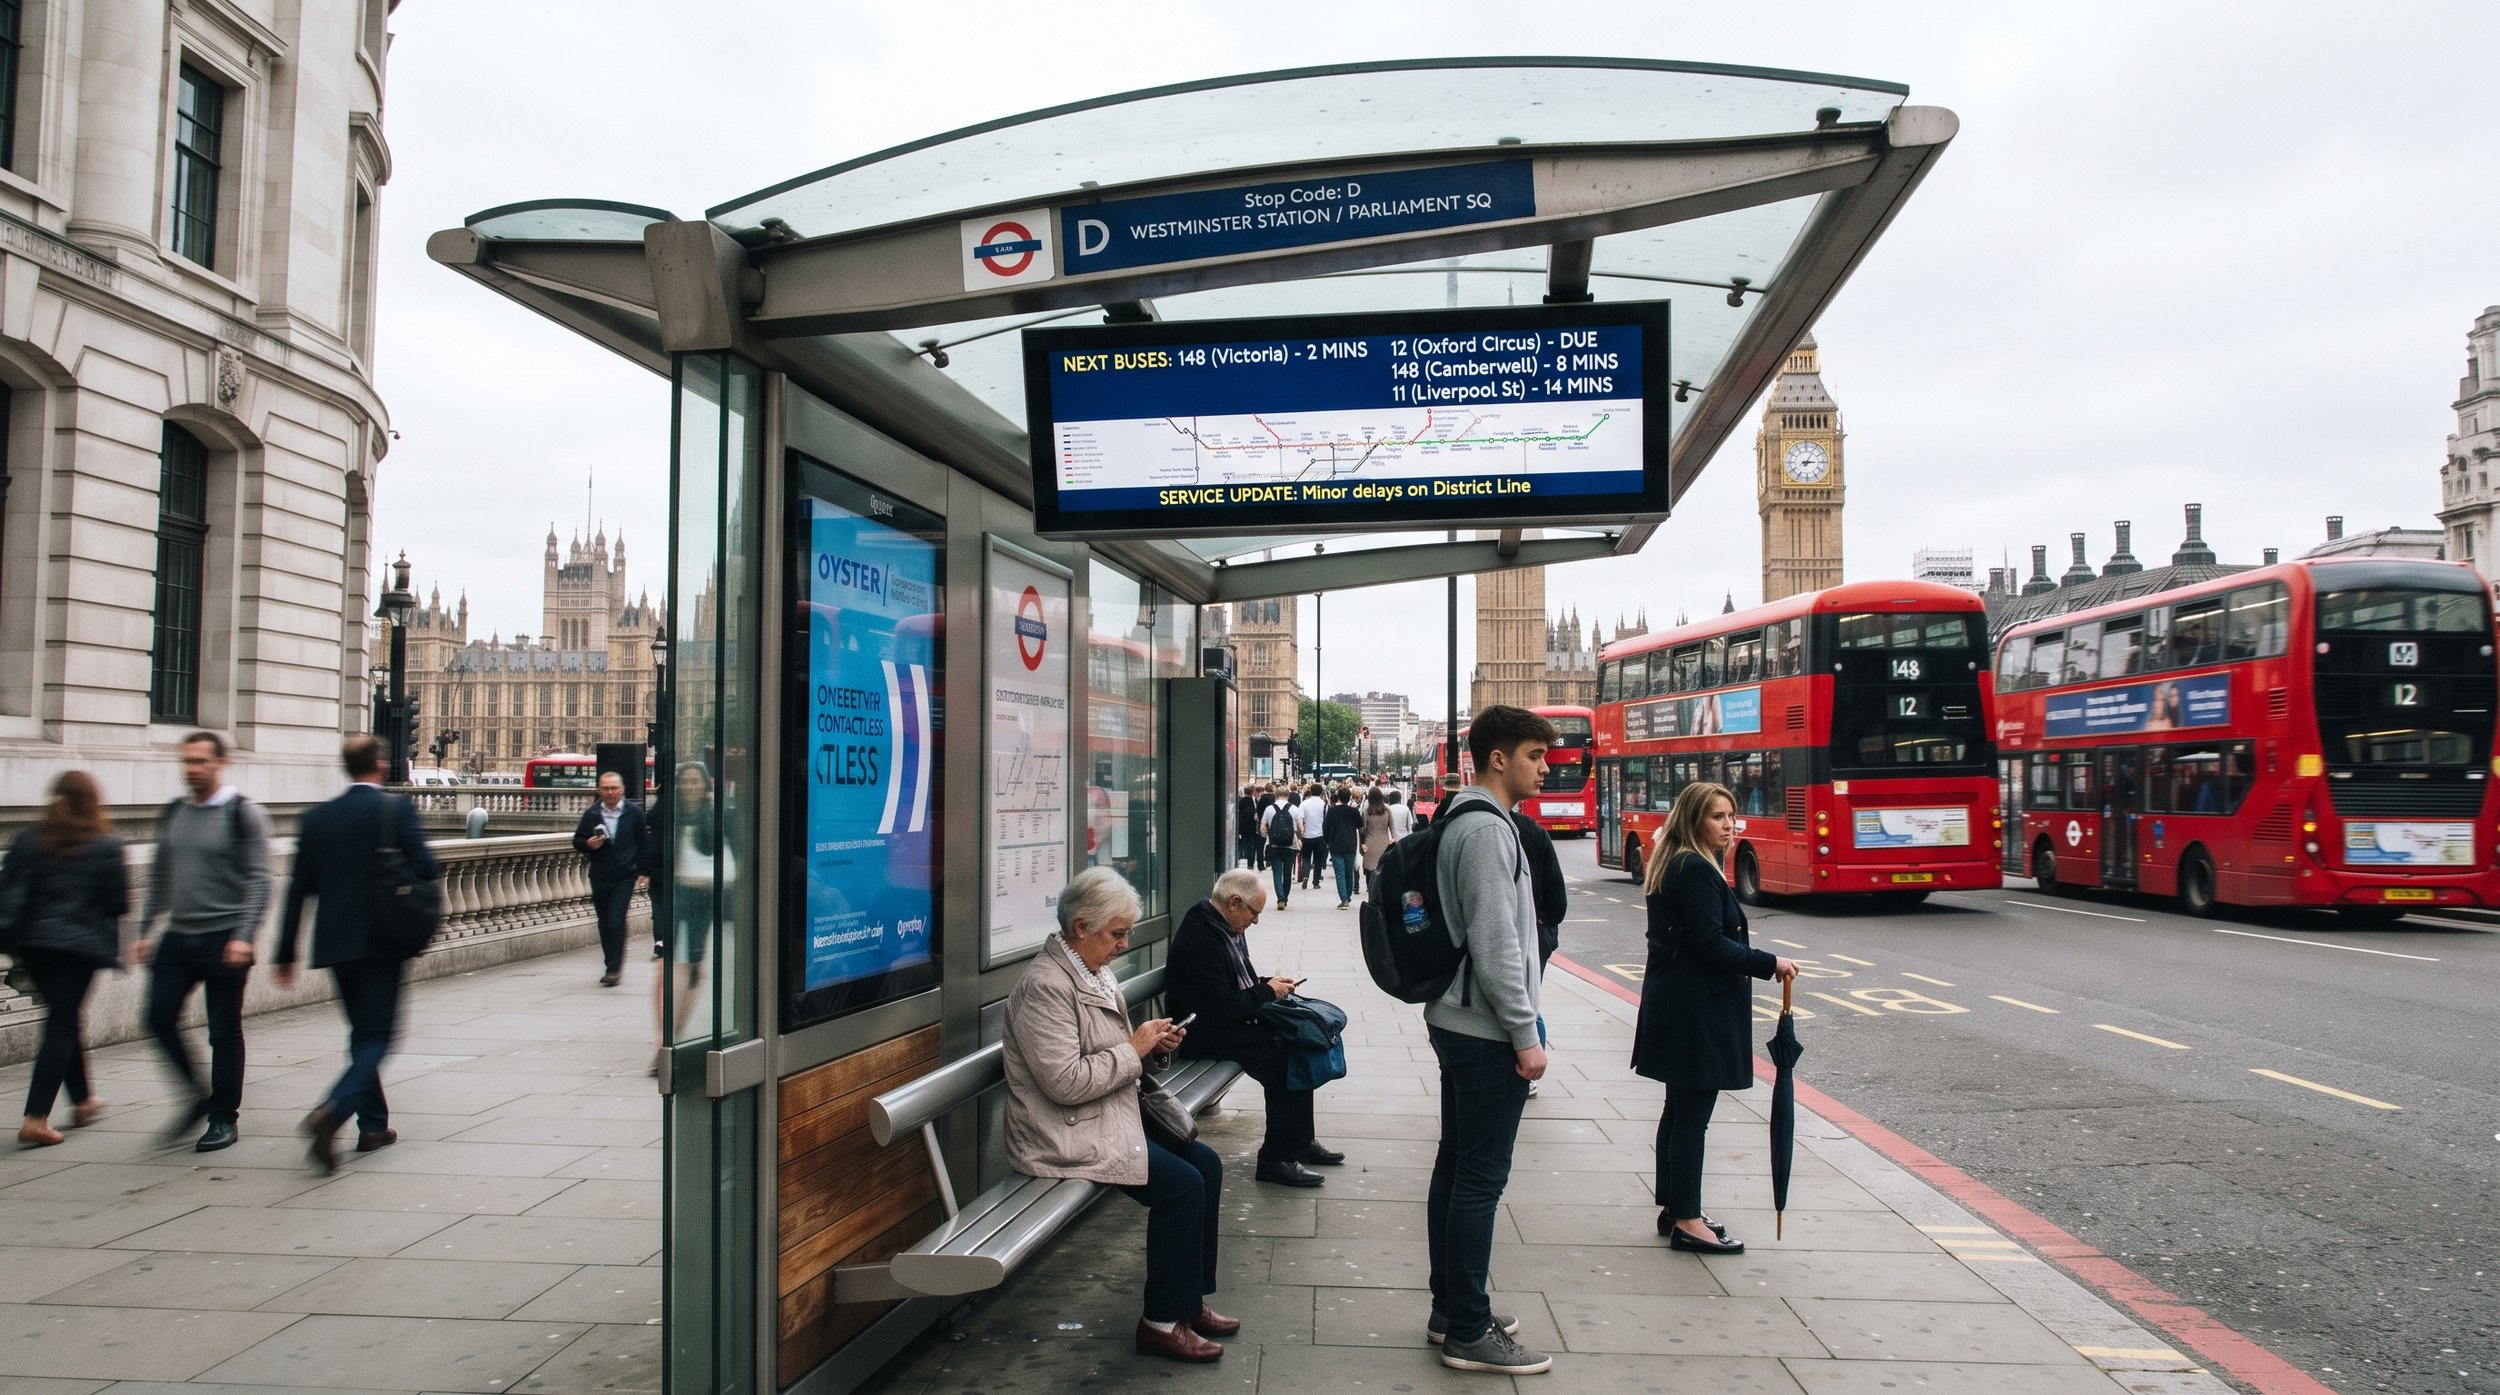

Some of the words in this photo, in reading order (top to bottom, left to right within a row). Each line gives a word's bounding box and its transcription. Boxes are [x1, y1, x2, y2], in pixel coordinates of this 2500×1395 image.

[1245, 192, 1285, 208] Stop
[1290, 186, 1342, 204] Code:
[1347, 183, 1361, 198] D
[1130, 215, 1253, 240] WESTMINSTER
[1257, 207, 1331, 229] STATION
[1336, 206, 1343, 224] /
[1349, 195, 1461, 219] PARLIAMENT
[1466, 192, 1492, 209] SQ
[1077, 218, 1110, 257] D
[1063, 354, 1108, 373] NEXT
[1114, 351, 1172, 370] BUSES:
[1177, 349, 1206, 366] 148
[1211, 344, 1288, 369] (Victoria)
[1306, 344, 1317, 360] 2
[1322, 341, 1368, 359] MINS
[1390, 340, 1407, 357] 12
[1412, 336, 1477, 359] (Oxford
[1560, 331, 1598, 349] DUE
[1391, 362, 1419, 380] 148
[1424, 355, 1538, 381] (Camberwell)
[1556, 355, 1567, 372] 8
[1572, 353, 1619, 371] MINS
[1393, 384, 1406, 401] 11
[1411, 381, 1498, 404] (Liverpool
[1501, 379, 1526, 400] St)
[1544, 378, 1563, 395] 14
[1567, 376, 1614, 394] MINS
[1160, 488, 1225, 505] SERVICE
[1230, 485, 1298, 503] UPDATE:
[1302, 484, 1348, 500] Minor
[1352, 483, 1403, 502] delays
[1407, 485, 1428, 497] on
[1433, 479, 1493, 496] District
[1497, 478, 1532, 494] Line
[818, 553, 881, 595] OYSTER
[1891, 659, 1921, 678] 148
[1899, 696, 1918, 716] 12
[2393, 683, 2418, 706] 12
[817, 713, 884, 736] CONTACTLESS
